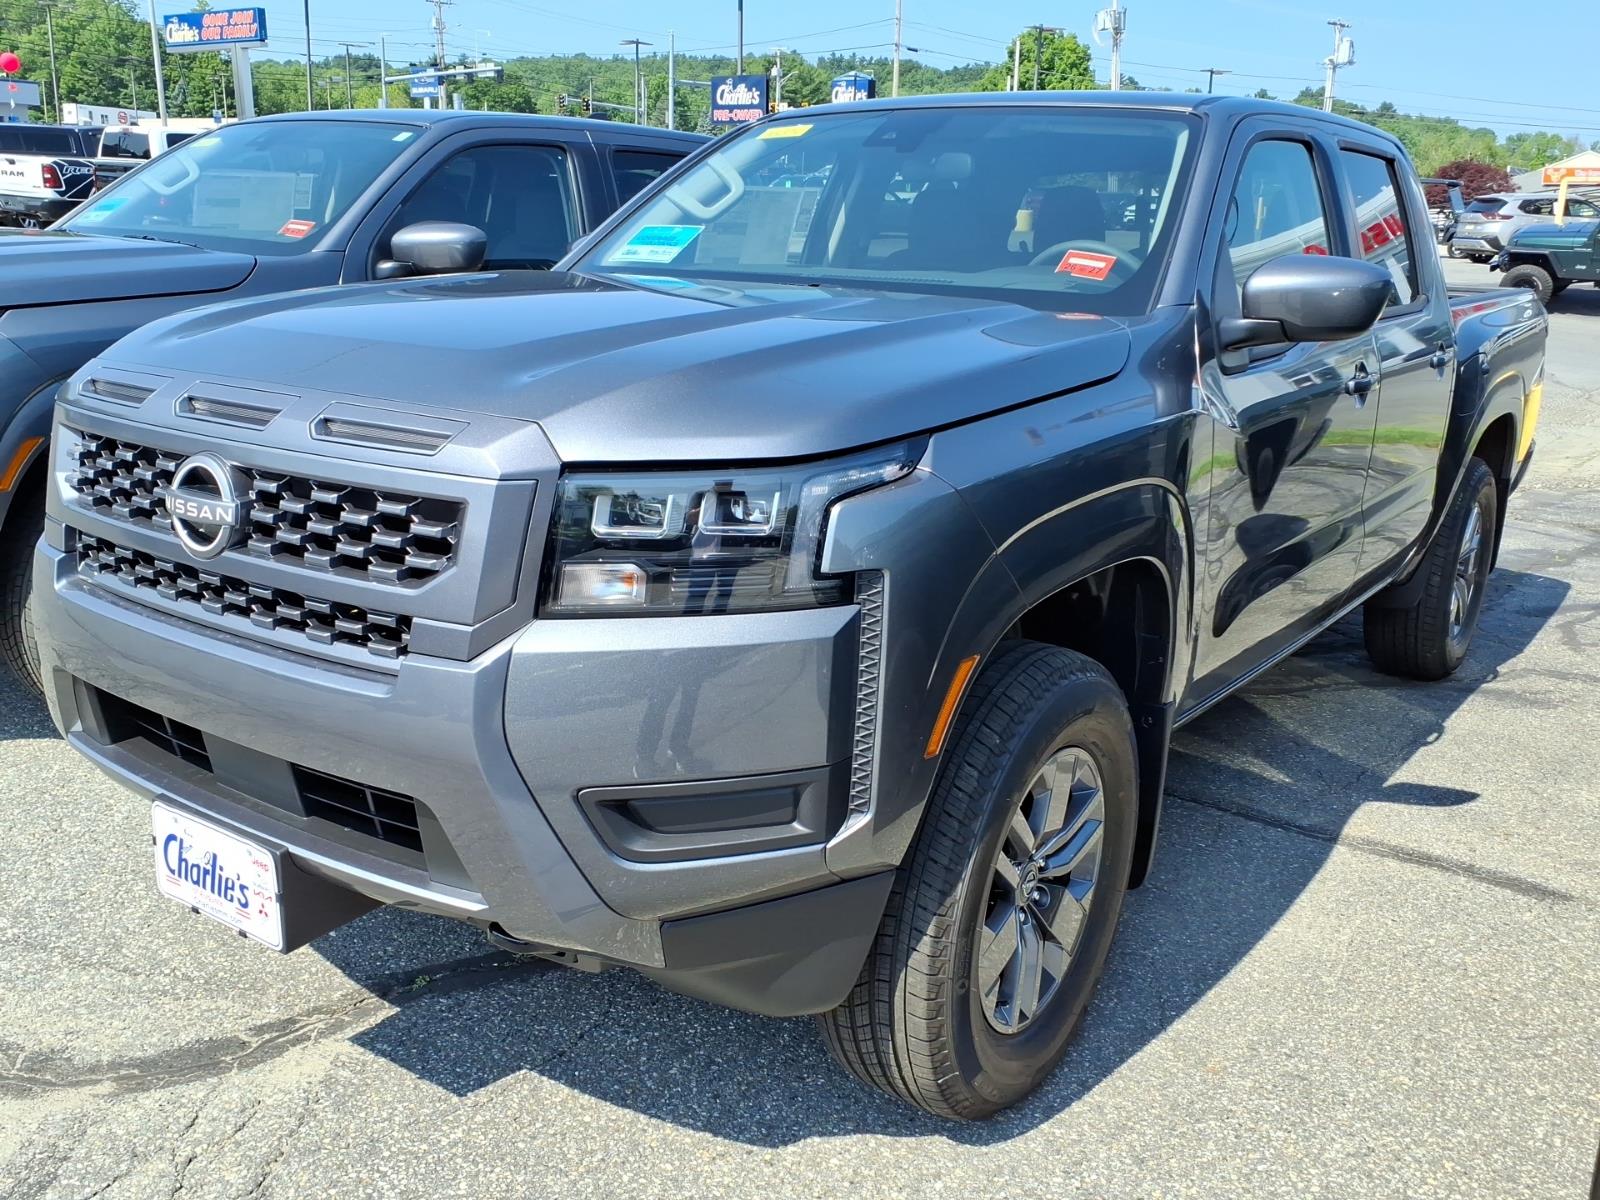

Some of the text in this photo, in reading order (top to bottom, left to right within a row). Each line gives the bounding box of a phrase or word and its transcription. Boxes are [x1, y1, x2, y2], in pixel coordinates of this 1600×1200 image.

[202, 9, 254, 27] COME JOIN
[166, 22, 199, 43] Charlie's
[201, 23, 258, 40] OUR FAMILY
[716, 83, 760, 105] Charlie's
[1, 169, 25, 177] RAM
[165, 494, 233, 523] NISSAN
[163, 833, 250, 909] Charlie's
